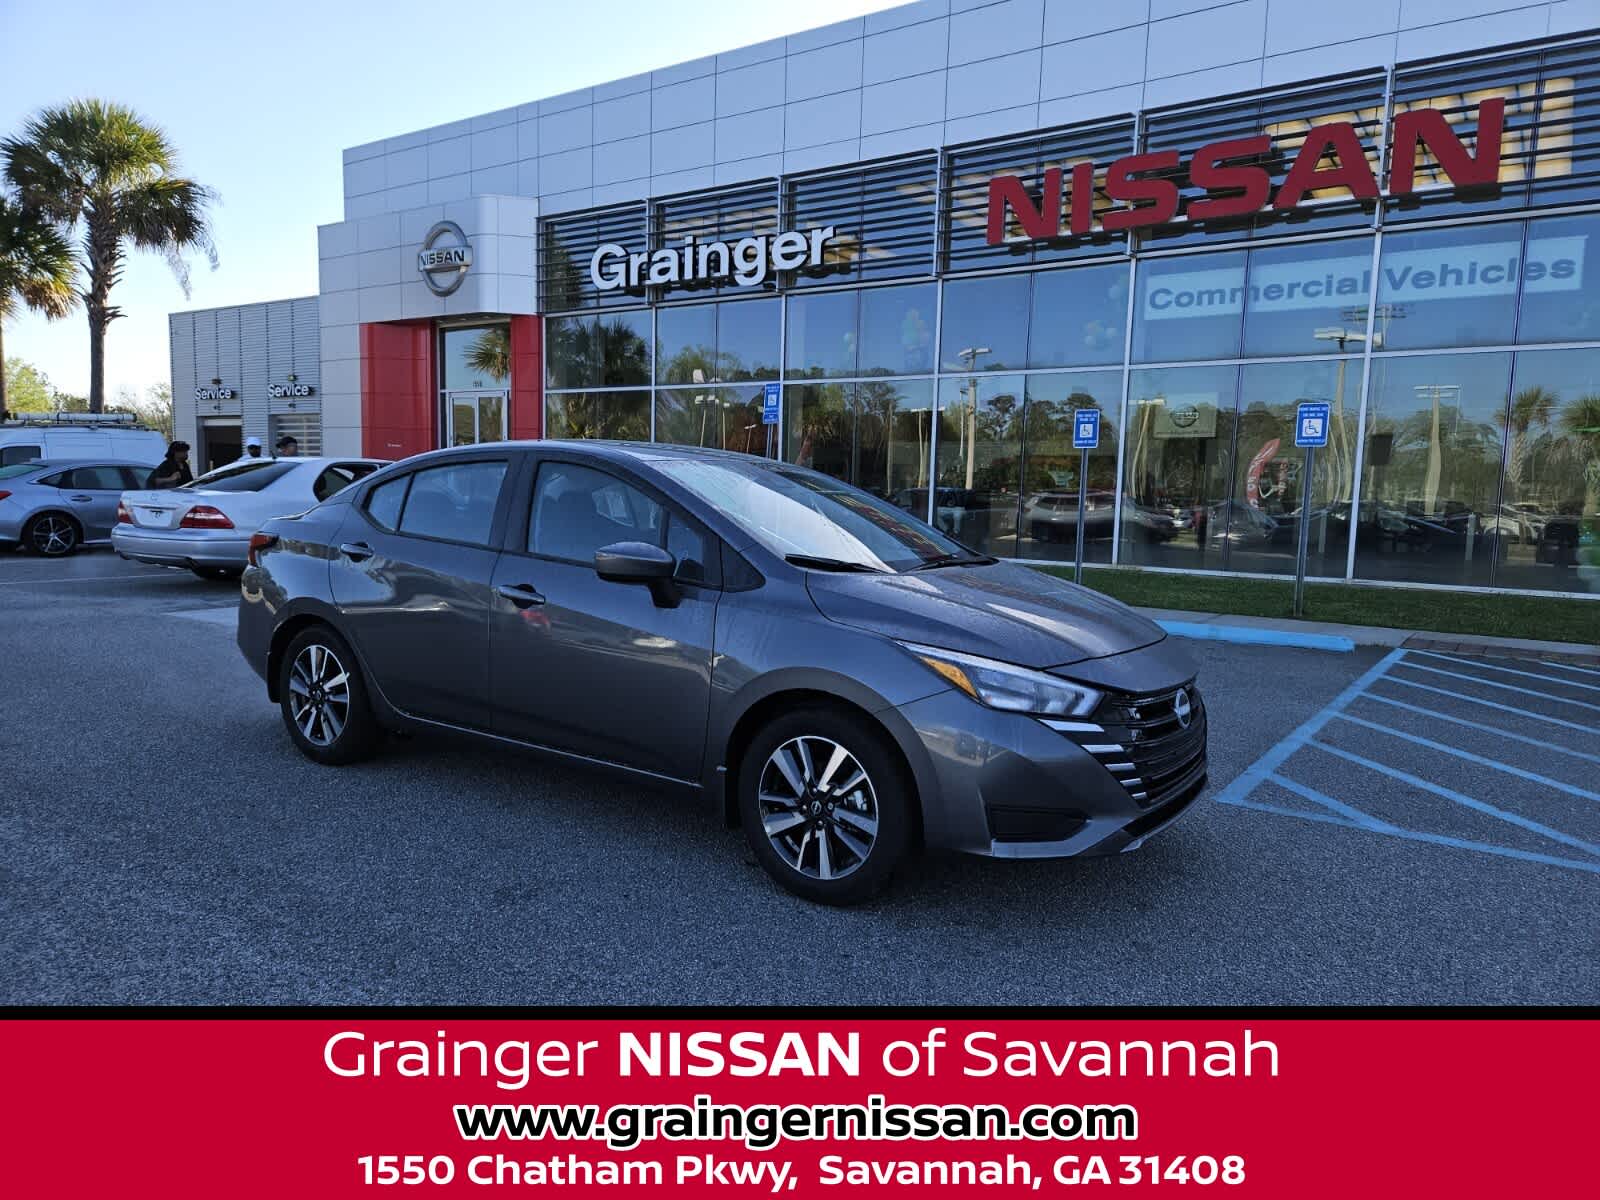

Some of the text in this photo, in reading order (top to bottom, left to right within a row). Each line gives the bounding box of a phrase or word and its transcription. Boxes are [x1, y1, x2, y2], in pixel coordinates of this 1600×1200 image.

[986, 97, 1505, 245] NISSAN
[420, 249, 465, 266] NISSAN
[590, 226, 834, 290] Grainger
[1150, 258, 1576, 310] Commercial Vehicles
[195, 388, 232, 400] Service
[267, 384, 310, 397] Service
